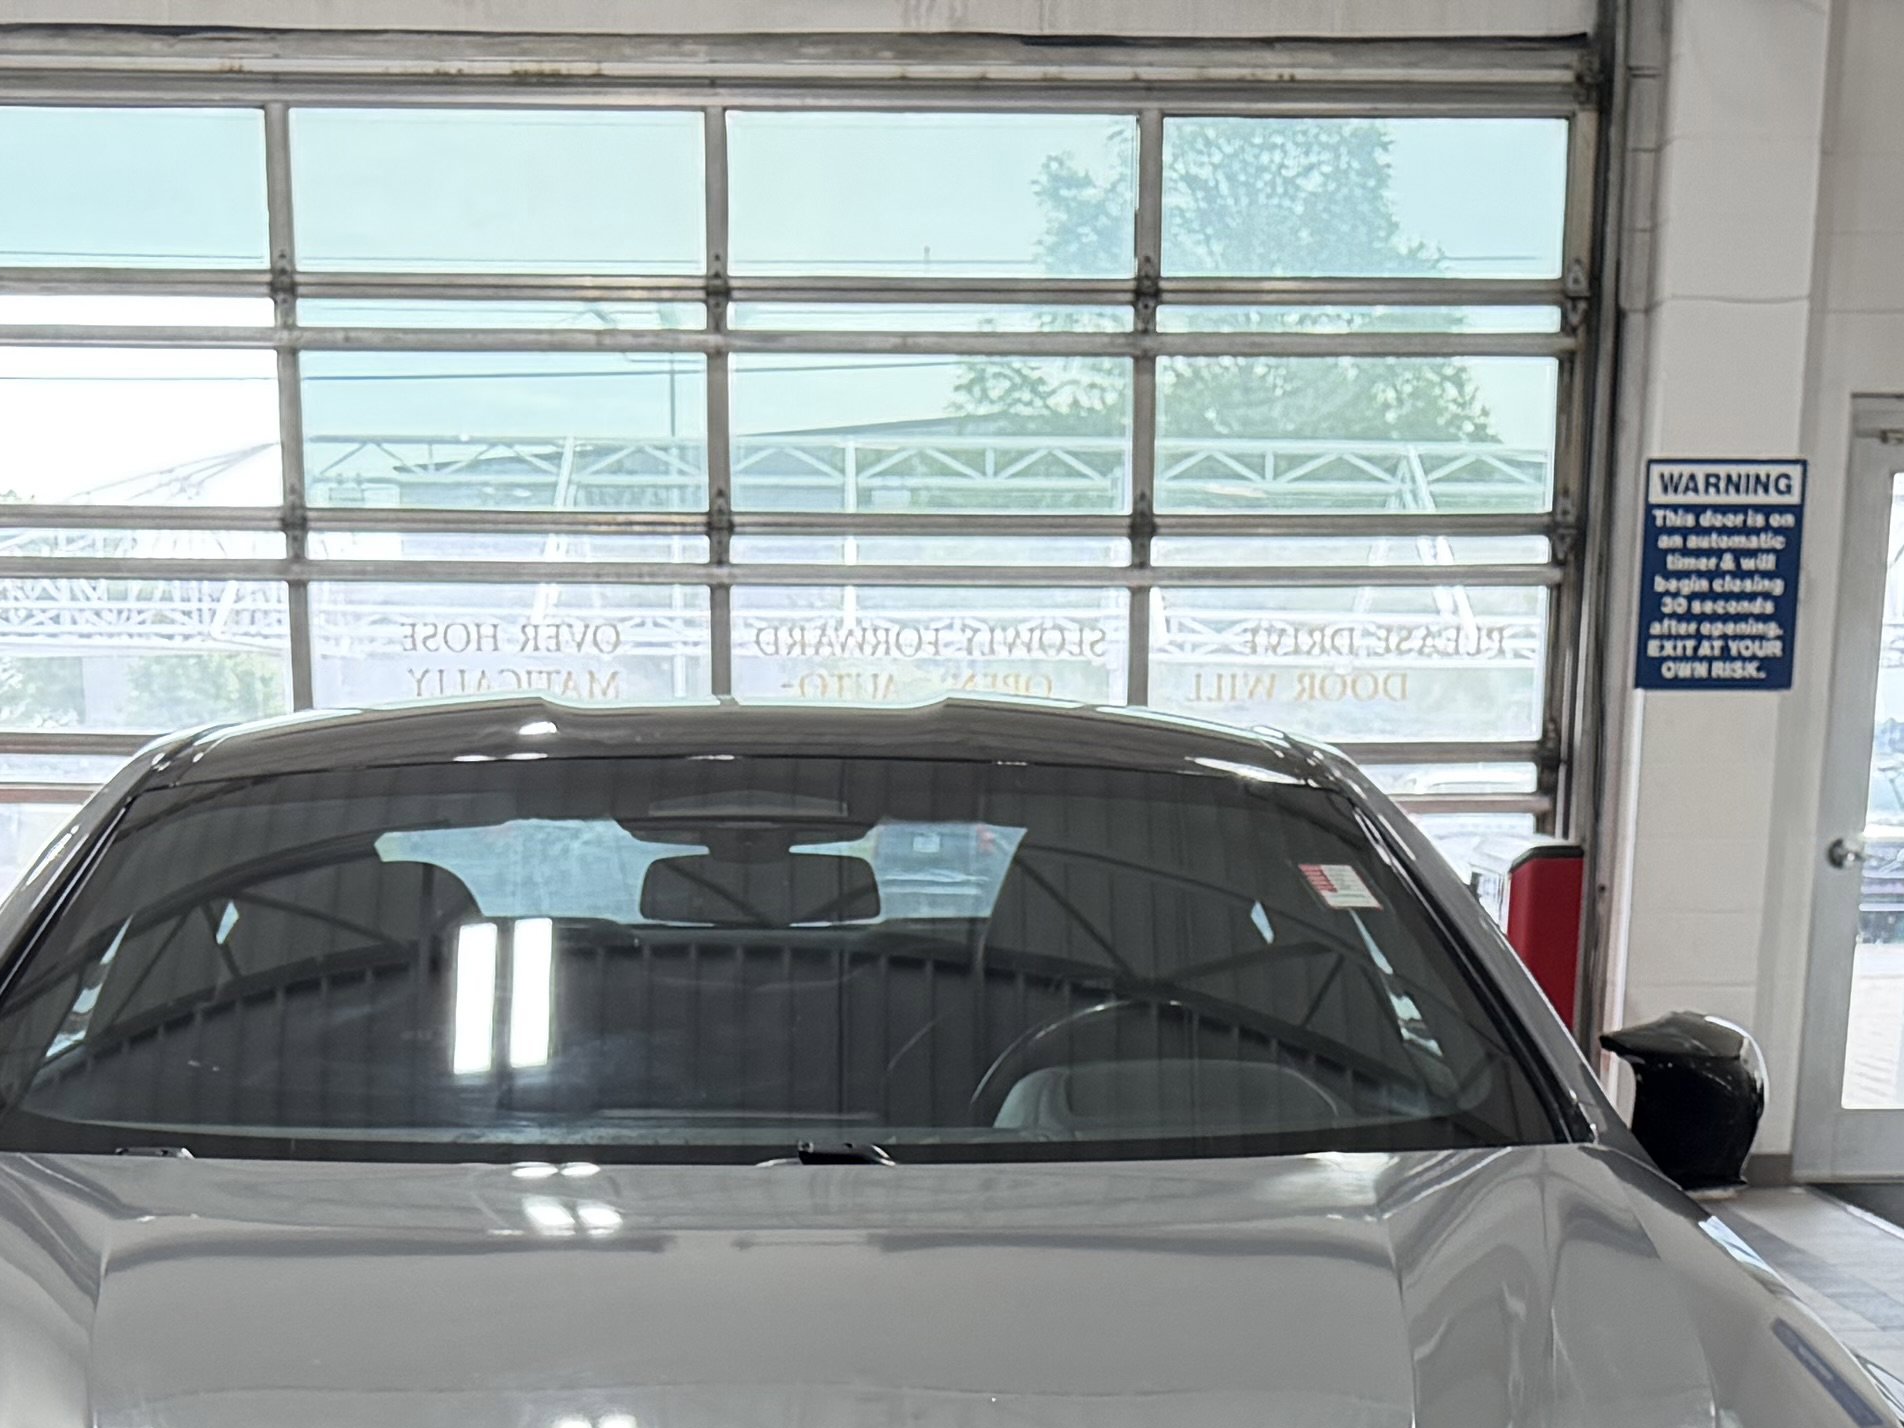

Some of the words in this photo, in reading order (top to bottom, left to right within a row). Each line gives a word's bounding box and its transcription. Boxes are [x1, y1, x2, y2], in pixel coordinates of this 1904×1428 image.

[1659, 472, 1793, 496] WARNING
[1652, 508, 1696, 528] This
[1698, 508, 1745, 528] door
[1747, 509, 1766, 528] is
[1768, 512, 1796, 528] on
[1657, 533, 1684, 549] an
[1686, 531, 1786, 550] automatic
[1666, 552, 1718, 571] timer
[1719, 552, 1736, 571] &
[1740, 553, 1777, 571] will
[1654, 573, 1710, 596] begin
[1711, 574, 1785, 596] closing
[1690, 596, 1776, 615] seconds
[1649, 617, 1698, 636] after
[1699, 617, 1784, 639] opening.
[1647, 639, 1697, 658] EXIT
[1697, 639, 1724, 658] AT
[1727, 639, 1784, 658] YOUR
[1661, 660, 1710, 679] OWN
[1711, 660, 1767, 679] RISK.
